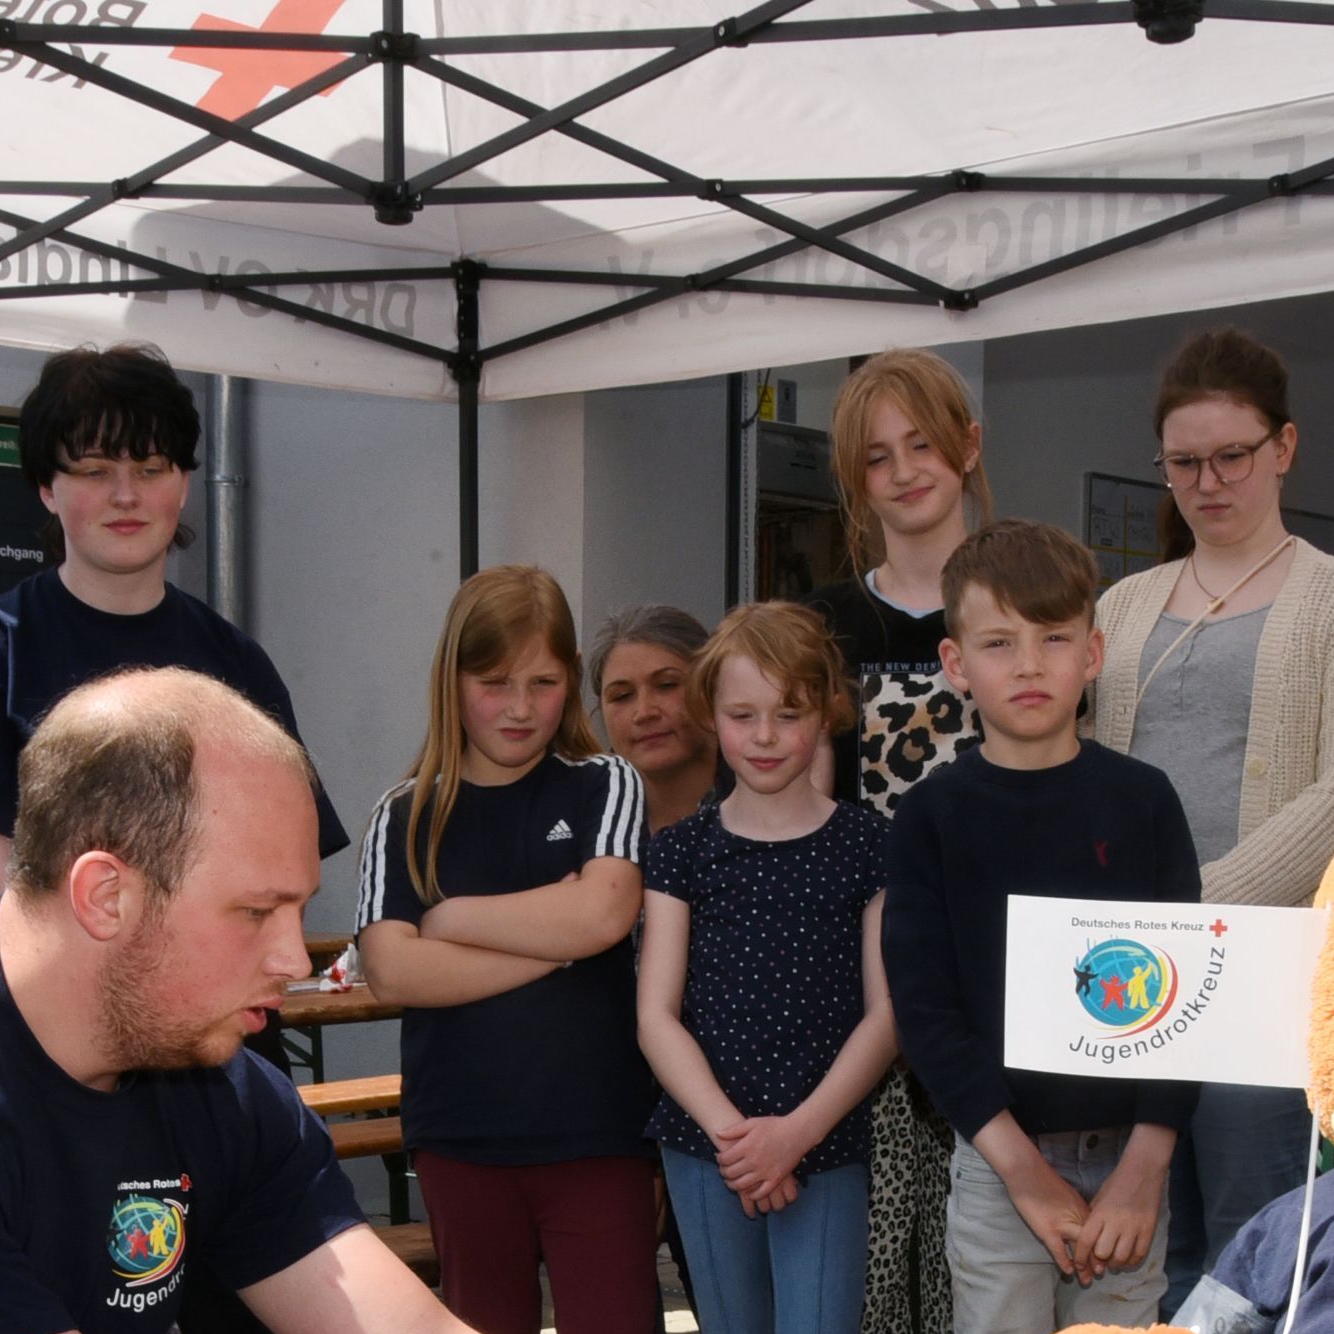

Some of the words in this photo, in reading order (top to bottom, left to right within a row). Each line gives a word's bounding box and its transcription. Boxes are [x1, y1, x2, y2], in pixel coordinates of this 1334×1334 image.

[860, 662, 881, 671] THE
[885, 662, 910, 672] NEW
[1071, 916, 1131, 930] Deutsches
[1134, 919, 1168, 931] Rotes
[1171, 920, 1204, 932] Kreuz
[1069, 945, 1226, 1064] Jugendrotkreuz
